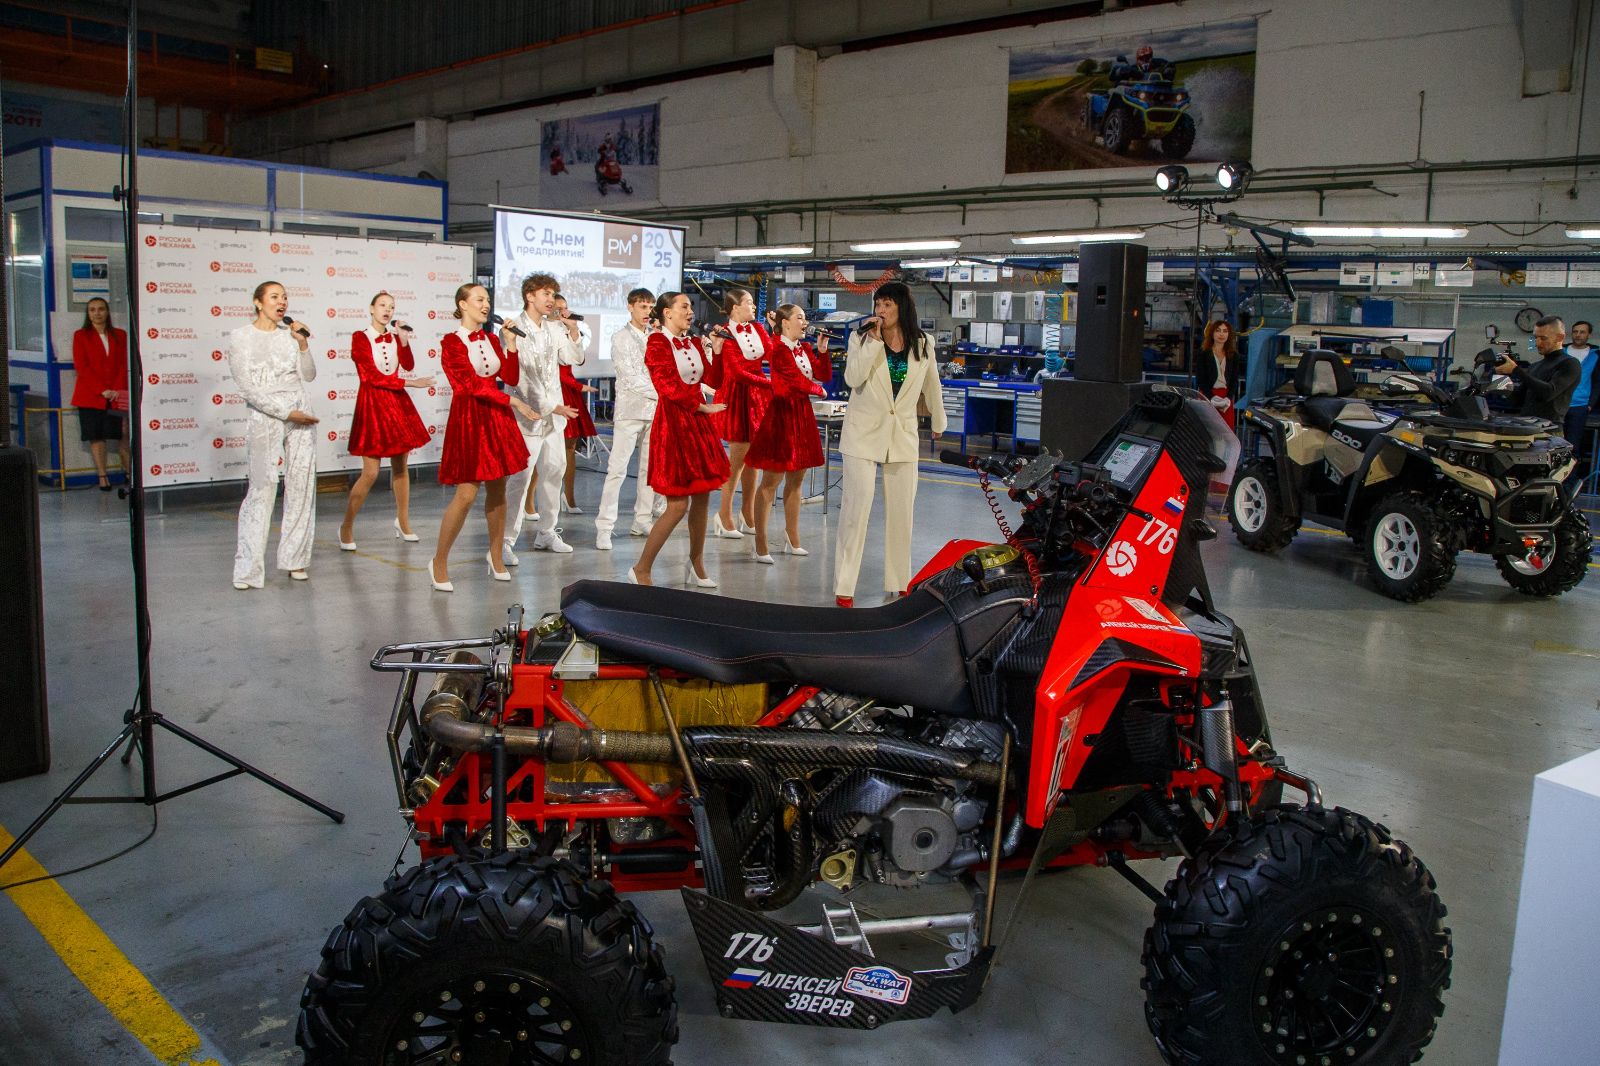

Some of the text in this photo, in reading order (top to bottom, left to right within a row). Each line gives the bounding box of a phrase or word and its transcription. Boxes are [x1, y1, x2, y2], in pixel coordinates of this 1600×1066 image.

[523, 226, 585, 247] С Днем
[644, 232, 664, 249] 20
[516, 245, 585, 258] предприятия!
[654, 251, 672, 268] 25
[1331, 429, 1362, 449] 800
[1136, 516, 1177, 554] 176
[724, 932, 778, 962] 176
[756, 972, 842, 996] АЛЕКСЕЙ
[853, 973, 904, 988] SILK WAY
[785, 992, 855, 1016] ЗВЕРЕВ
